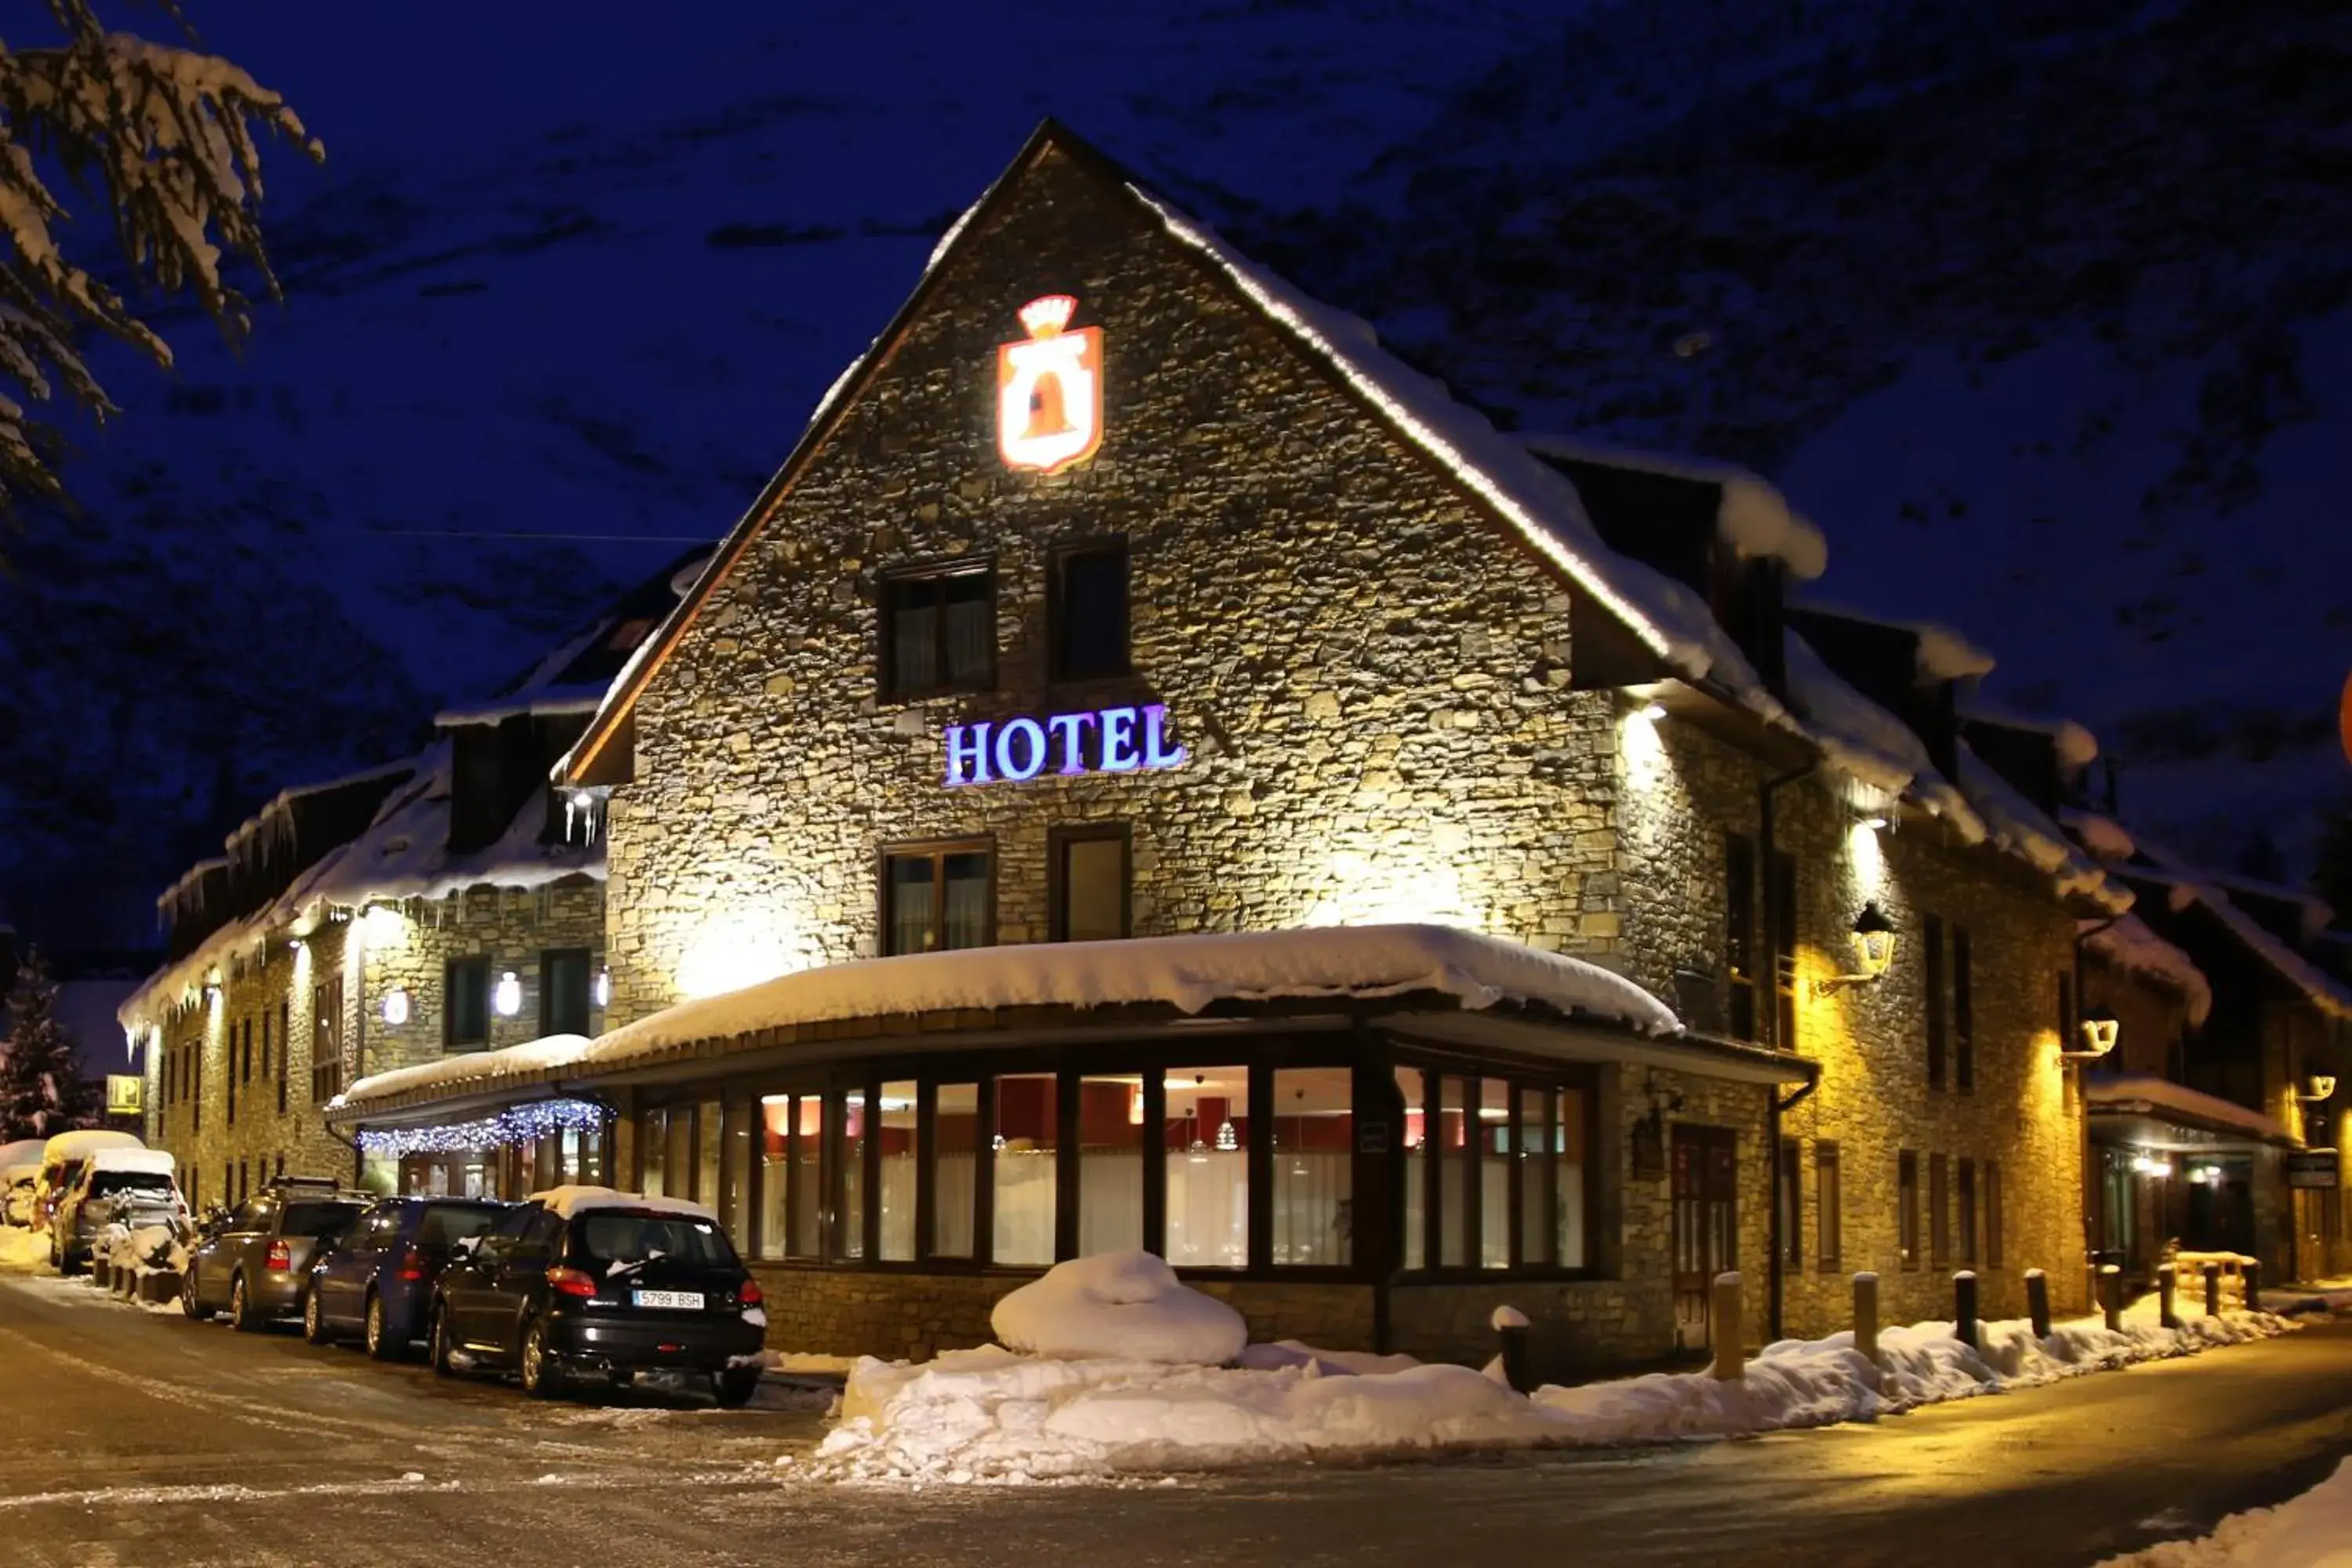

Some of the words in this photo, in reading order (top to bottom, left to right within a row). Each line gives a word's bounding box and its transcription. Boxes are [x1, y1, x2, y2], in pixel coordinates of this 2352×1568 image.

[945, 705, 1185, 785] HOTEL
[118, 1079, 137, 1105] P
[642, 1291, 672, 1305] 5799
[678, 1294, 700, 1307] BSH
